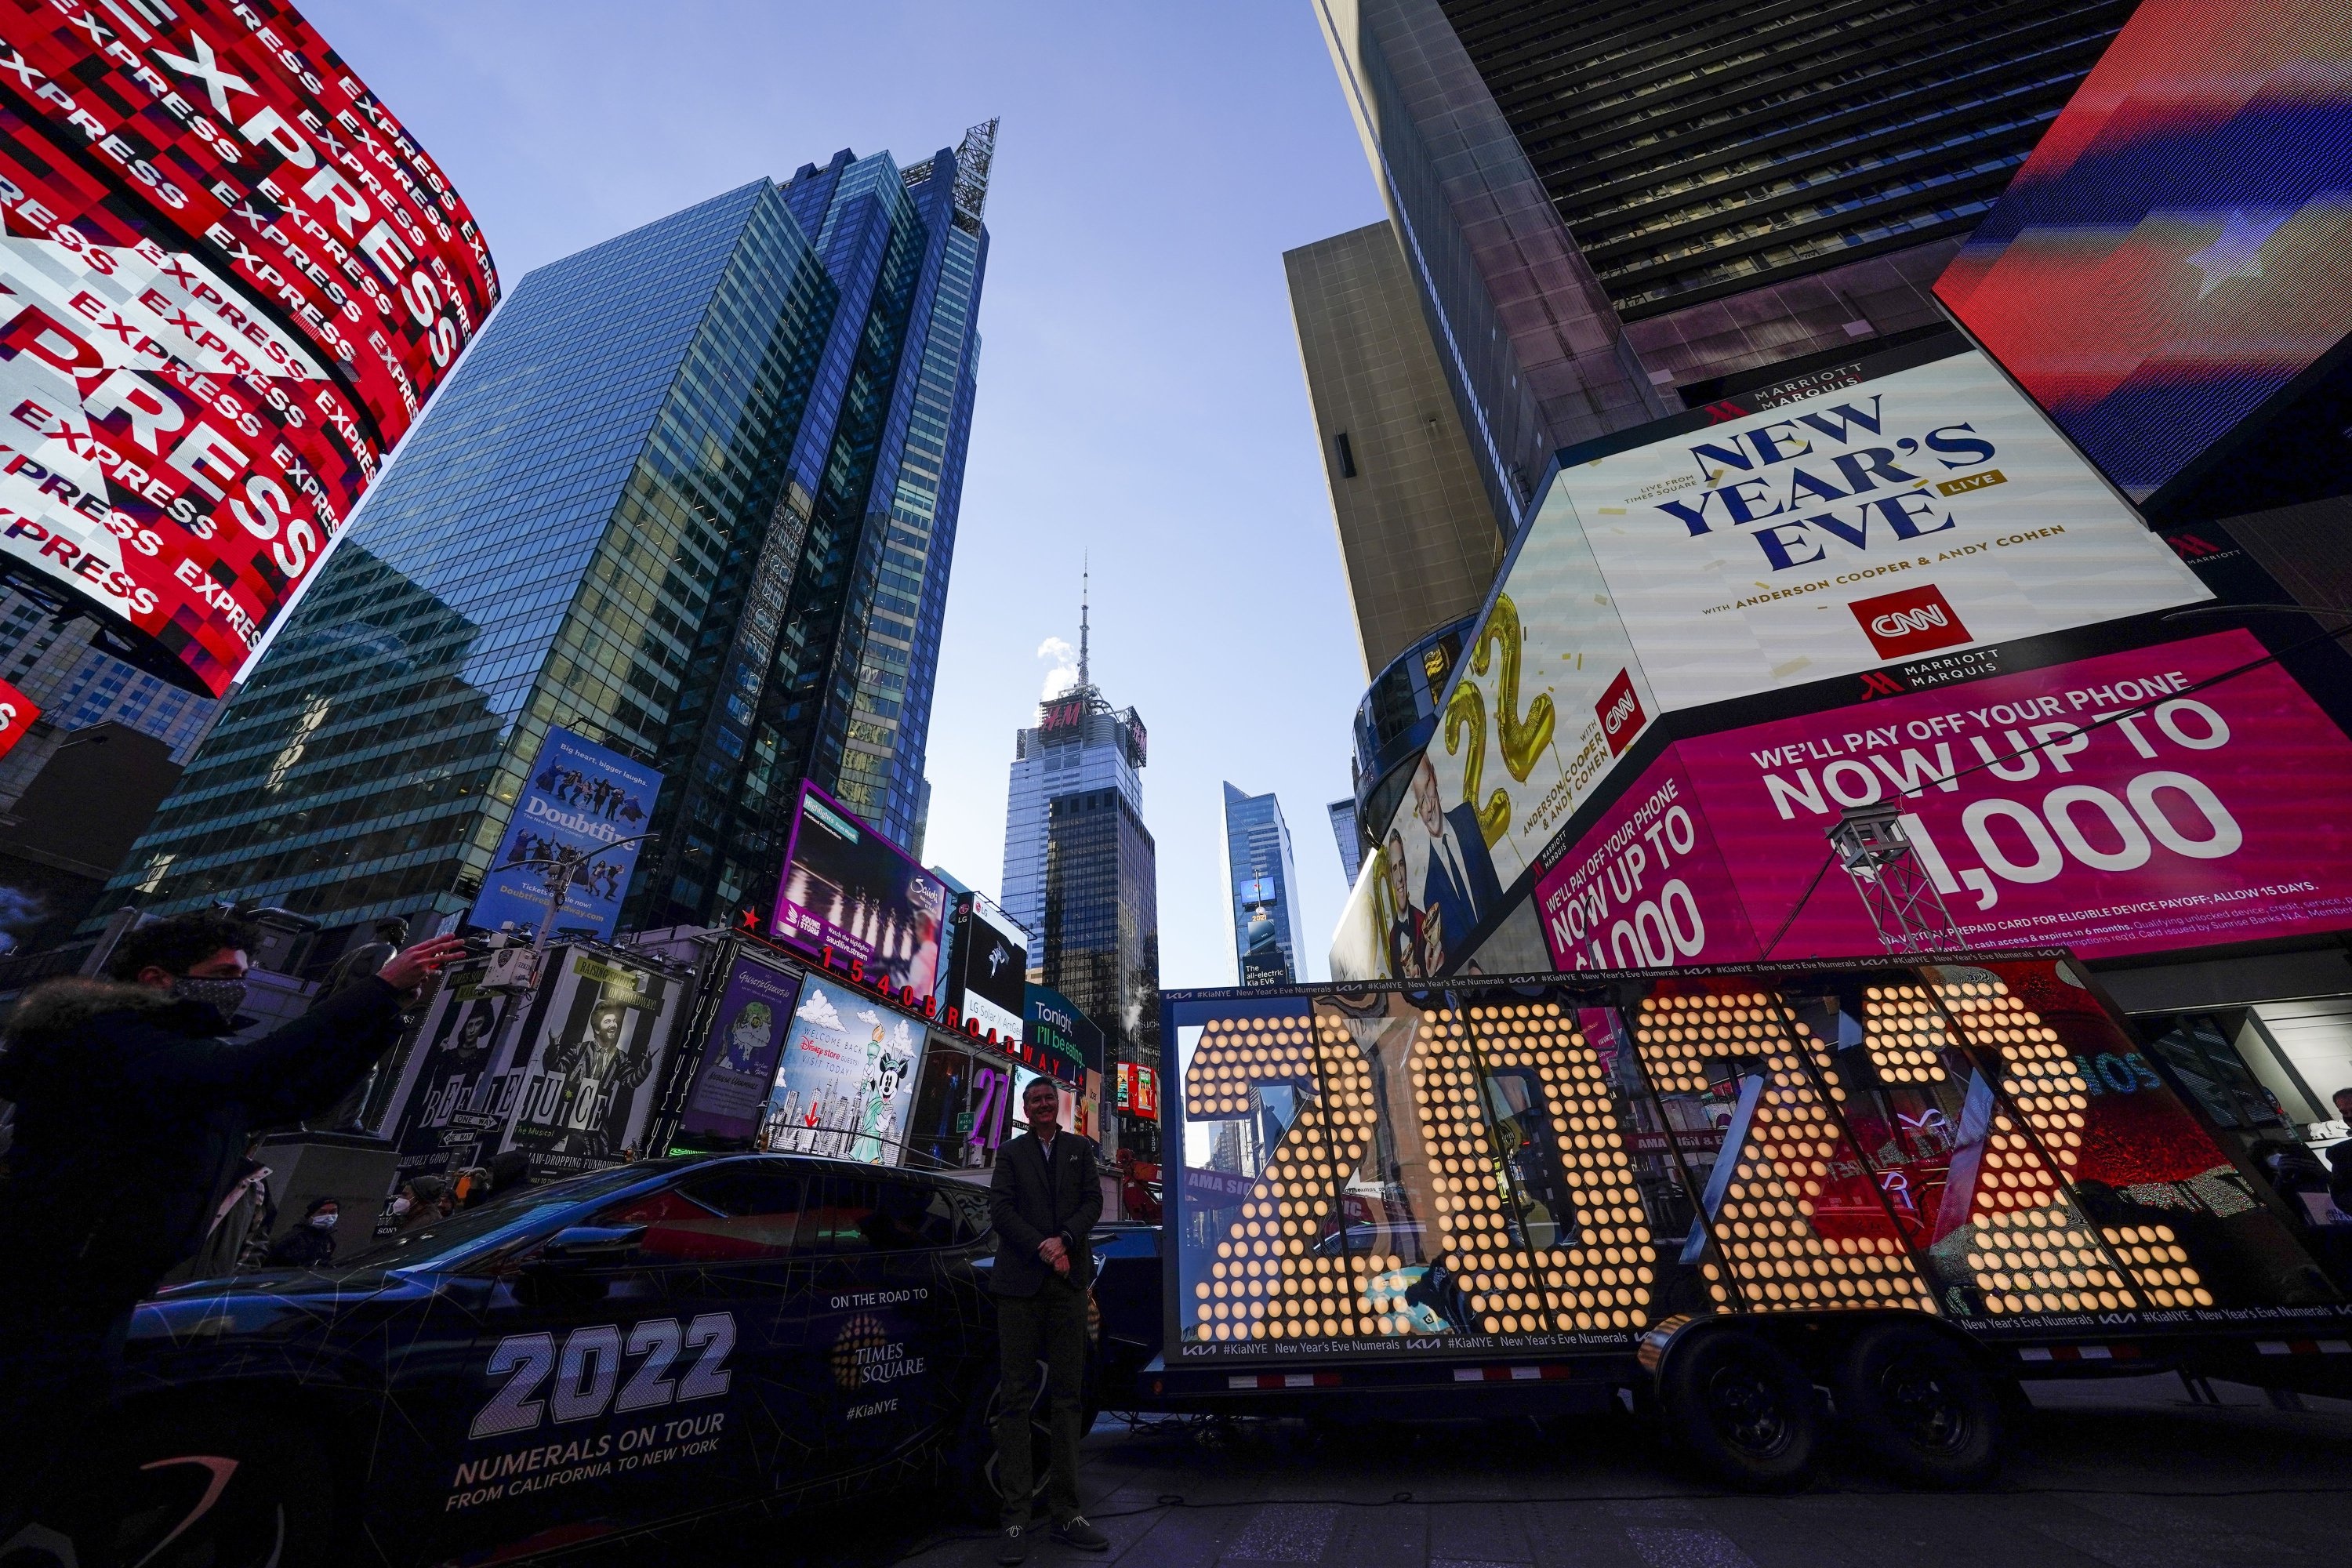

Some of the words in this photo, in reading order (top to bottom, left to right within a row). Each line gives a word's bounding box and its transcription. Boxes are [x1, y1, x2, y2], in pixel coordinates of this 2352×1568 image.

[338, 76, 456, 211] EXPRESS
[297, 109, 426, 247] EXPRESS
[336, 109, 452, 243] EXPRESS
[210, 180, 363, 323] EXPRESS
[256, 177, 394, 315] EXPRESS
[205, 222, 357, 361] EXPRESS
[132, 237, 308, 383] EXPRESS
[68, 290, 263, 437] EXPRESS
[138, 288, 307, 429] EXPRESS
[1755, 362, 1864, 401] MARRIOTT
[1761, 376, 1860, 412] MARQUIS
[1689, 394, 1884, 482] NEW
[9, 399, 217, 540] EXPRESS
[1640, 483, 1660, 494] LIVE
[1662, 474, 1695, 489] FROM
[1653, 421, 1997, 538] YEAR'S
[1947, 474, 1994, 494] LIVE
[1624, 491, 1655, 504] TIMES
[1657, 480, 1698, 497] SQUARE
[1751, 488, 1956, 572] EVE
[1702, 604, 1731, 615] WITH
[1736, 580, 1831, 609] ANDERSON
[1836, 560, 1913, 585] COOPER
[1917, 557, 1932, 567] &
[1937, 541, 1988, 562] ANDY
[1997, 524, 2066, 548] COHEN
[2187, 549, 2241, 565] MARRIOTT
[1871, 604, 1949, 638] CNN
[1904, 648, 2000, 676] MARRIOTT
[1911, 662, 1998, 688] MARQUIS
[1041, 702, 1081, 731] H&M
[1605, 688, 1636, 735] CNN
[1751, 738, 1844, 770] WE'LL
[1843, 724, 1898, 753] PAY
[1907, 713, 1967, 741] OFF
[1967, 695, 2059, 728] YOUR
[2065, 671, 2190, 712] PHONE
[1133, 722, 1147, 750] H&M
[1581, 719, 1597, 742] WITH
[560, 742, 574, 757] Big
[575, 748, 597, 766] heart,
[598, 758, 622, 779] bigger
[623, 770, 648, 787] laughs.
[1762, 742, 1959, 820] NOW
[1972, 721, 2090, 782] UP
[2091, 698, 2230, 761] TO
[1523, 782, 1564, 837] ANDERSON
[1564, 731, 1604, 783] COOPER
[1551, 787, 1573, 822] ANDY
[1575, 748, 1609, 791] COHEN
[523, 812, 534, 822] The
[535, 816, 546, 826] New
[524, 796, 636, 852] Doubtfire
[804, 797, 834, 824] Highlights
[1542, 831, 1566, 860] MARRIOTT
[1544, 843, 1567, 869] MARQUIS
[1546, 887, 1570, 914] WE'LL
[1570, 866, 1588, 893] PAY
[1587, 849, 1605, 874] OFF
[1604, 824, 1635, 858] YOUR
[1633, 778, 1679, 832] PHONE
[1552, 875, 1609, 953] NOW
[1607, 844, 1646, 904] UP
[1644, 805, 1694, 870] TO
[981, 906, 988, 917] LG
[1948, 924, 1997, 938] PREPAID
[1998, 918, 2033, 931] CARD
[2034, 914, 2058, 926] FOR
[2058, 906, 2112, 922] ELIGIBLE
[2111, 902, 2158, 916] DEVICE
[2160, 895, 2213, 910] PAYOFF;
[2213, 888, 2260, 902] ALLOW
[2260, 886, 2278, 895] 15
[2277, 880, 2320, 895] DAYS.
[800, 922, 820, 937] STORM
[828, 926, 841, 938] Watch
[1975, 941, 1997, 950] cash
[1997, 935, 2030, 946] access
[2038, 930, 2074, 944] expires
[2092, 922, 2133, 935] months.
[2134, 916, 2184, 931] Qualifying
[2185, 910, 2230, 924] unlocked
[2139, 930, 2164, 938] Card
[2165, 925, 2196, 937] issued
[2197, 922, 2209, 933] by
[2211, 917, 2249, 931] Sunrise
[2251, 915, 2281, 925] Banks
[580, 962, 608, 979] RAISING
[820, 946, 913, 1007] 1540
[1247, 970, 1283, 980] all-electric
[1247, 978, 1260, 987] Kia
[608, 987, 617, 998] ON
[619, 990, 657, 1011] BROADWAY!
[1196, 989, 1231, 998] #KiaNYE
[1254, 987, 1278, 996] Year's
[1279, 986, 1294, 995] Eve
[1295, 984, 1331, 994] Numerals
[969, 1000, 978, 1013] LG
[980, 1004, 996, 1022] Solar
[1036, 1001, 1073, 1036] Tonight,
[805, 1027, 841, 1047] WELCOME
[844, 1041, 862, 1054] BACK
[923, 994, 1060, 1076] BROADWAY
[1051, 1031, 1064, 1050] be
[803, 1055, 823, 1068] VISIT
[826, 1062, 853, 1076] TODAY!
[823, 1049, 840, 1060] store
[478, 1118, 494, 1127] WAY
[969, 1068, 1008, 1149] 21
[459, 1133, 473, 1142] WAY
[514, 1125, 528, 1134] The
[528, 1127, 555, 1138] Musical
[1185, 982, 2215, 1340] 2022
[831, 1296, 849, 1308] ON
[852, 1294, 876, 1306] THE
[879, 1290, 910, 1304] ROAD
[913, 1288, 927, 1300] TO
[1961, 1318, 1986, 1331] New
[1987, 1316, 2021, 1330] Year's
[2021, 1315, 2042, 1327] Eve
[2041, 1313, 2095, 1327] Numerals
[2142, 1310, 2193, 1323] #KiaNYE
[2195, 1308, 2220, 1322] New
[2220, 1306, 2256, 1320] Year's
[2256, 1306, 2278, 1319] Eve
[2277, 1305, 2332, 1319] Numerals
[855, 1342, 903, 1366] TIMES
[1223, 1343, 1268, 1355] #KiaNYE
[1275, 1343, 1298, 1354] New
[1299, 1341, 1330, 1353] Year's
[1332, 1341, 1351, 1352] Eve
[1352, 1339, 1400, 1351] Numerals
[468, 1311, 737, 1440] 2022
[862, 1357, 924, 1383] SQUARE
[847, 1398, 898, 1421] #KiaNYE
[453, 1435, 611, 1487] NUMERALS
[619, 1425, 657, 1451] ON
[665, 1413, 725, 1443] TOUR
[445, 1484, 503, 1512] FROM
[509, 1462, 612, 1497] CALIFORNIA
[619, 1457, 638, 1472] TO
[641, 1446, 678, 1466] NEW
[681, 1437, 720, 1457] YORK
